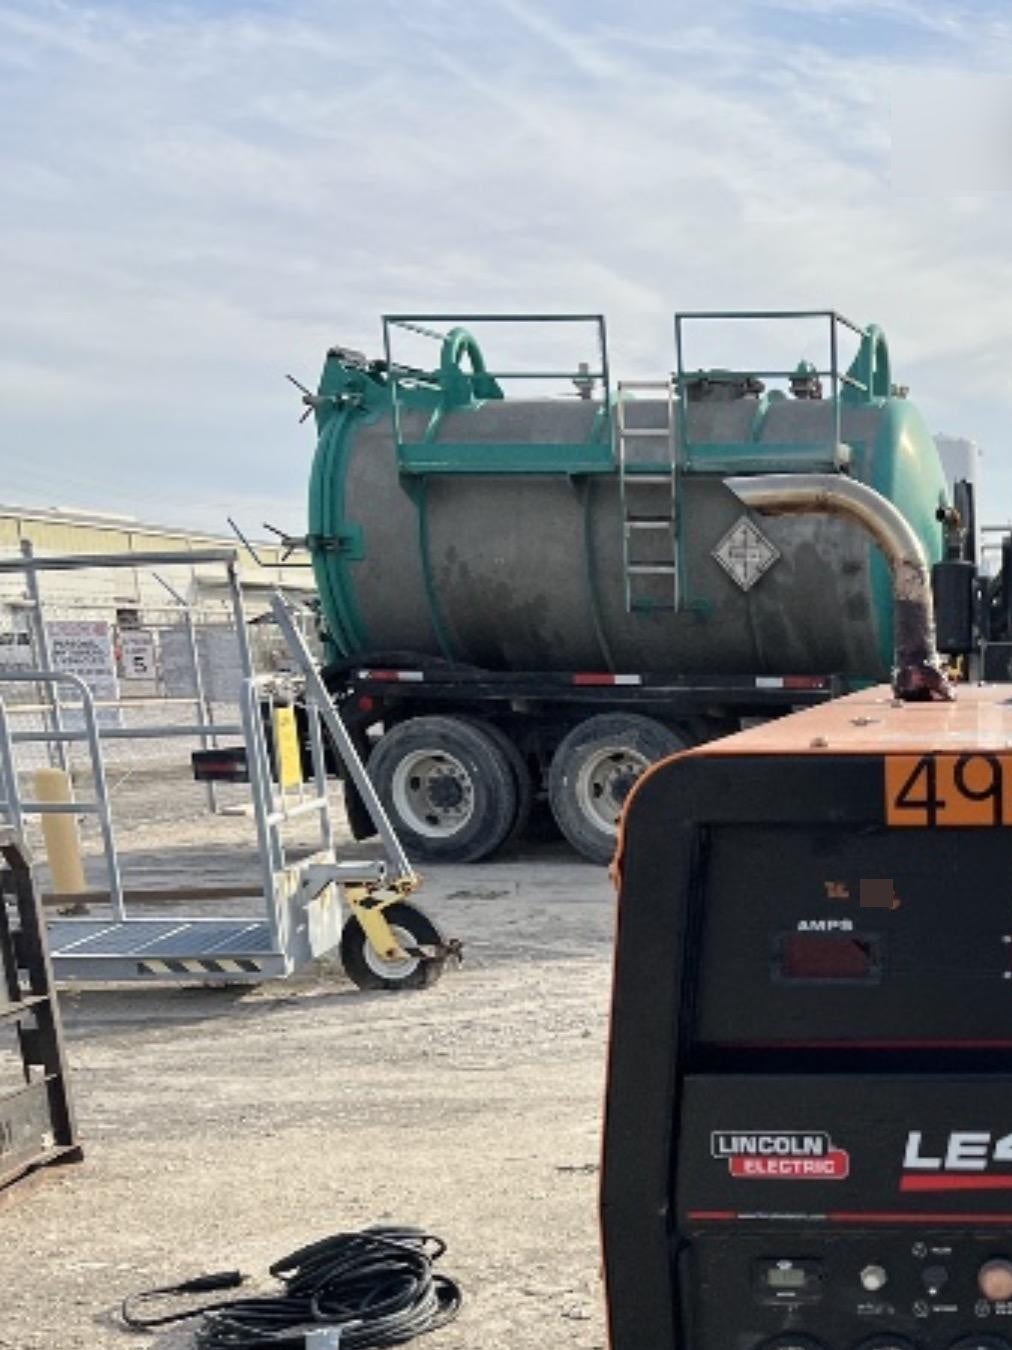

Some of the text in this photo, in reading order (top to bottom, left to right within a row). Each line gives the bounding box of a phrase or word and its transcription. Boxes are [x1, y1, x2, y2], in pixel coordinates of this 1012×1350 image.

[134, 656, 147, 672] 5
[797, 919, 853, 931] AMPS
[719, 1135, 824, 1156] LINCOLN
[744, 1159, 835, 1174] ELECTRIC
